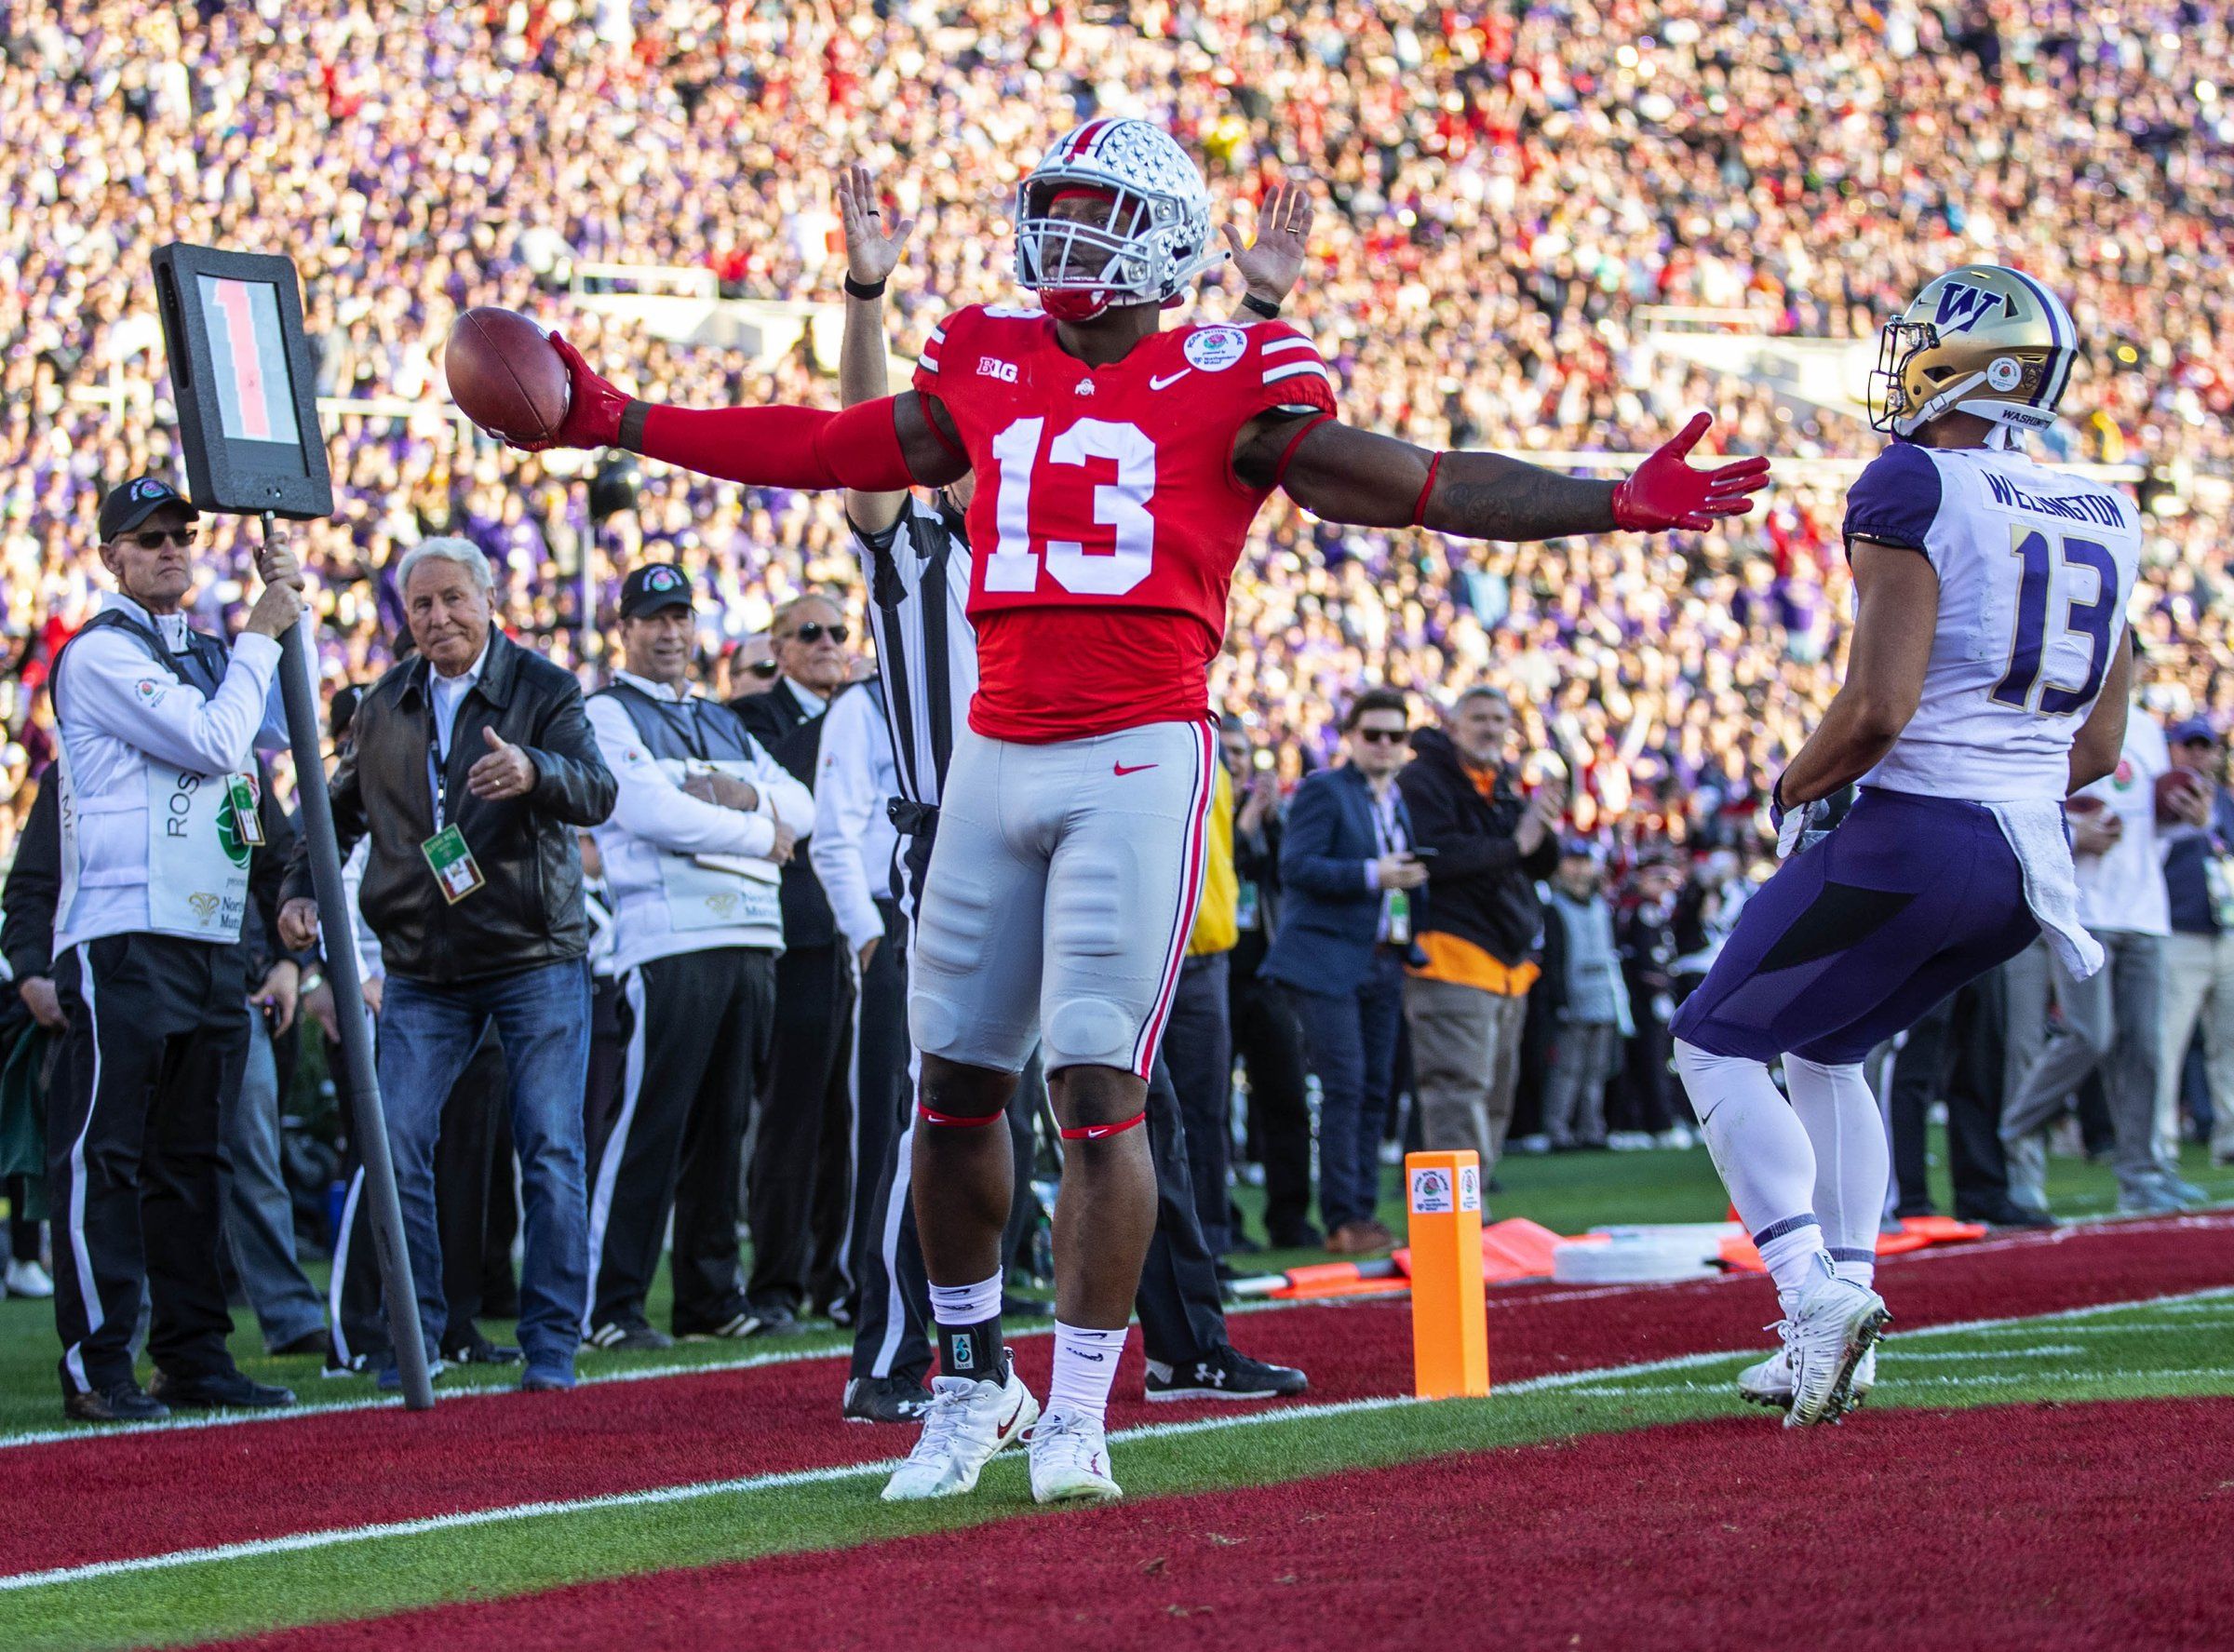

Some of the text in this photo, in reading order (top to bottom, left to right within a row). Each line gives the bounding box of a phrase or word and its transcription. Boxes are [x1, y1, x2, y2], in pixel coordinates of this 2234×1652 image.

[213, 279, 271, 439] 1
[1934, 281, 2005, 335] W
[984, 416, 1156, 596] 13
[1986, 523, 2119, 718] 13
